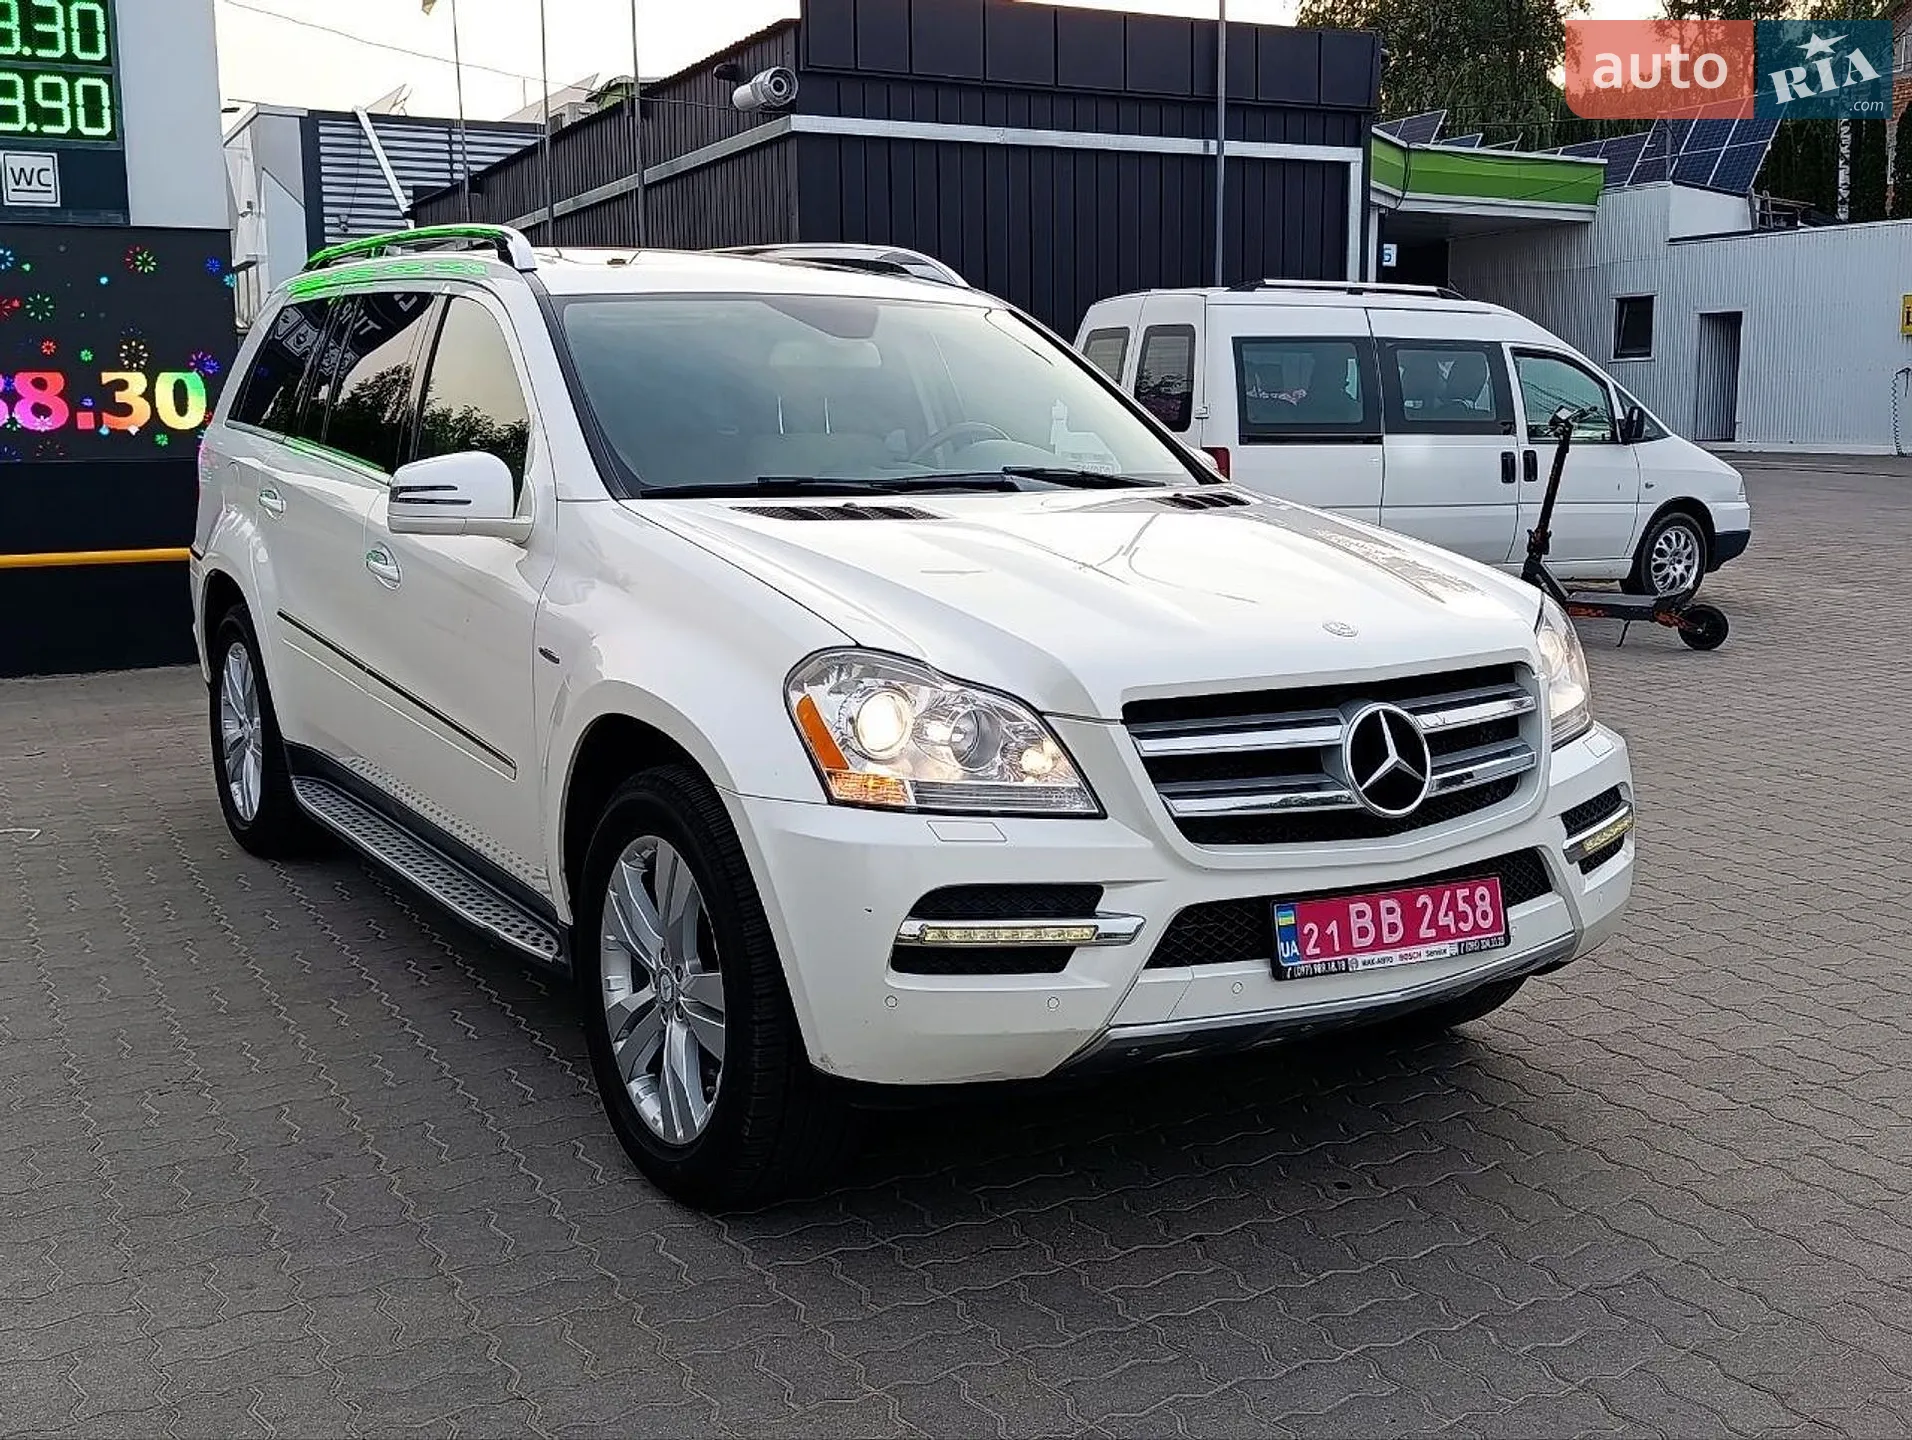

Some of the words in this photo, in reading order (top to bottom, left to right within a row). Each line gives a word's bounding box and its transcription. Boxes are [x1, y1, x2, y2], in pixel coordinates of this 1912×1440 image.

[10, 166, 52, 188] WC
[0, 371, 207, 431] 8.30
[1302, 919, 1341, 956] 21
[1349, 899, 1404, 948] BB
[1416, 886, 1495, 939] 2458
[1280, 942, 1300, 958] UA
[1398, 950, 1422, 962] BOSCH
